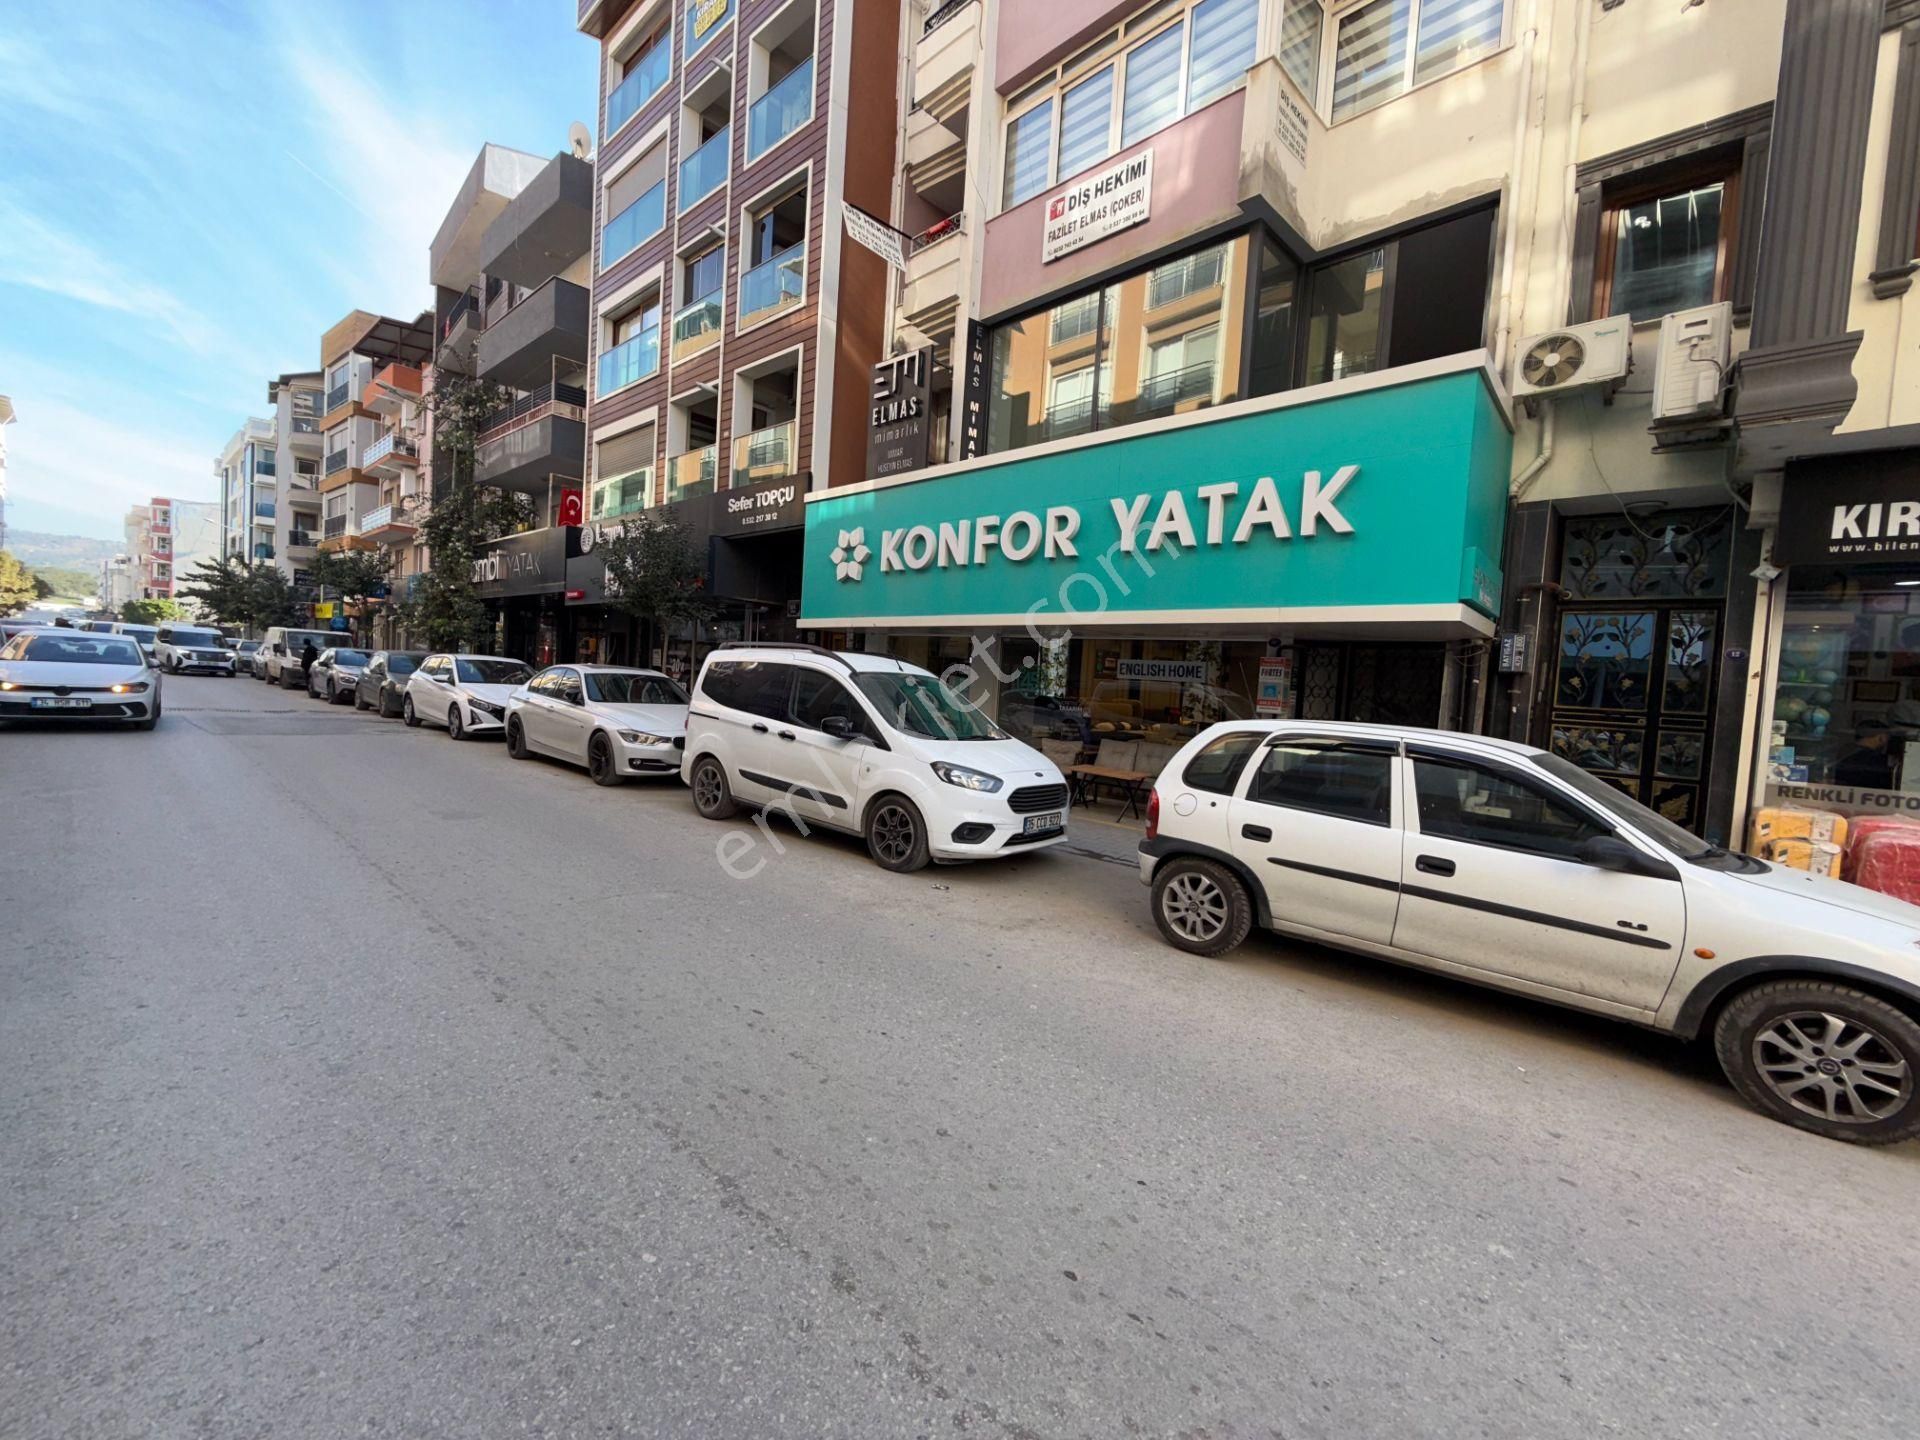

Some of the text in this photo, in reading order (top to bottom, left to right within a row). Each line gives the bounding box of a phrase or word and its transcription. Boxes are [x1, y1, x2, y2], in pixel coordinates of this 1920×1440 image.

[1068, 155, 1147, 211] DİŞ HEKİMİ
[1047, 220, 1078, 243] FAZİLET
[1080, 206, 1107, 229] ELMAS
[972, 326, 983, 387] ELMAS
[871, 396, 918, 427] ELMAS
[728, 485, 795, 513] Sefer TOPÇU
[880, 464, 1361, 573] KONFOR YATAK
[507, 552, 542, 577] YATAK
[1119, 663, 1203, 679] ENGLISH HOME
[1777, 785, 1854, 804] RENKLİ
